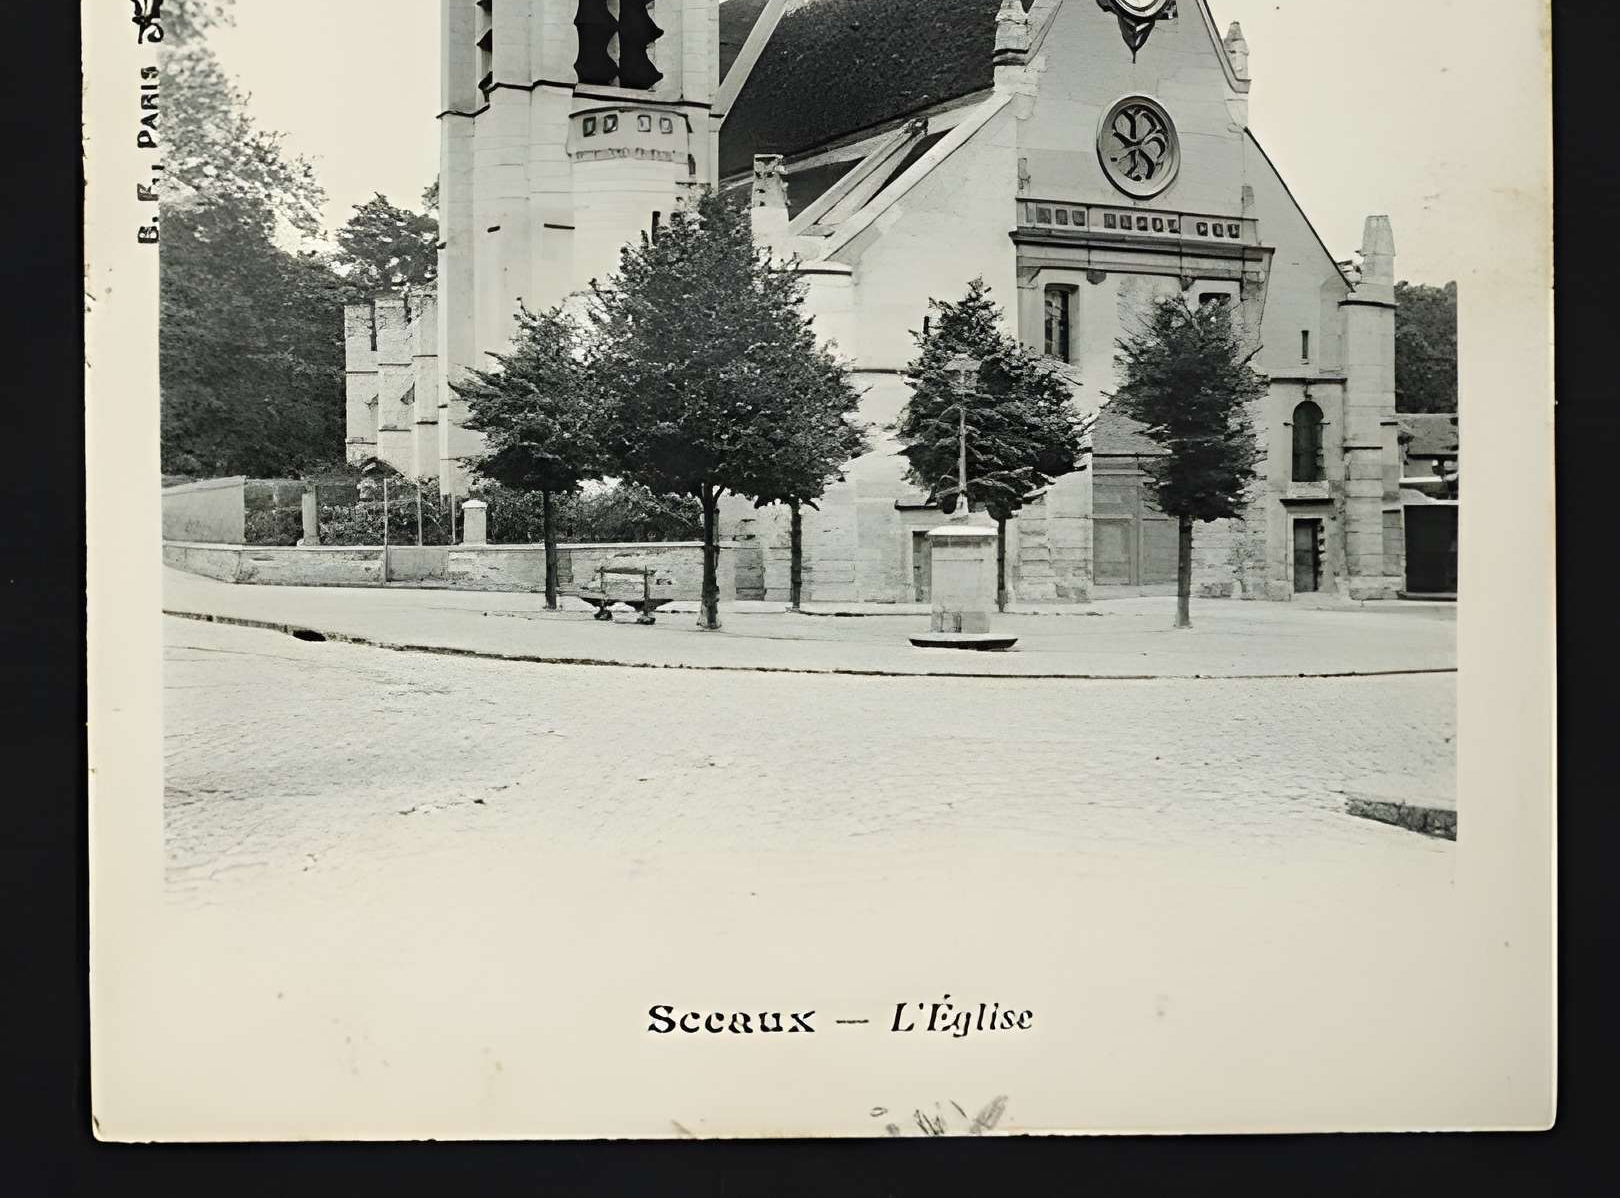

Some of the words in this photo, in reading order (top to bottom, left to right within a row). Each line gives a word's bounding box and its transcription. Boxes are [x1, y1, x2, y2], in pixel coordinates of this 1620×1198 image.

[136, 66, 160, 149] PARIS
[647, 1004, 816, 1035] Sceaux
[890, 993, 1034, 1038] L'Église
